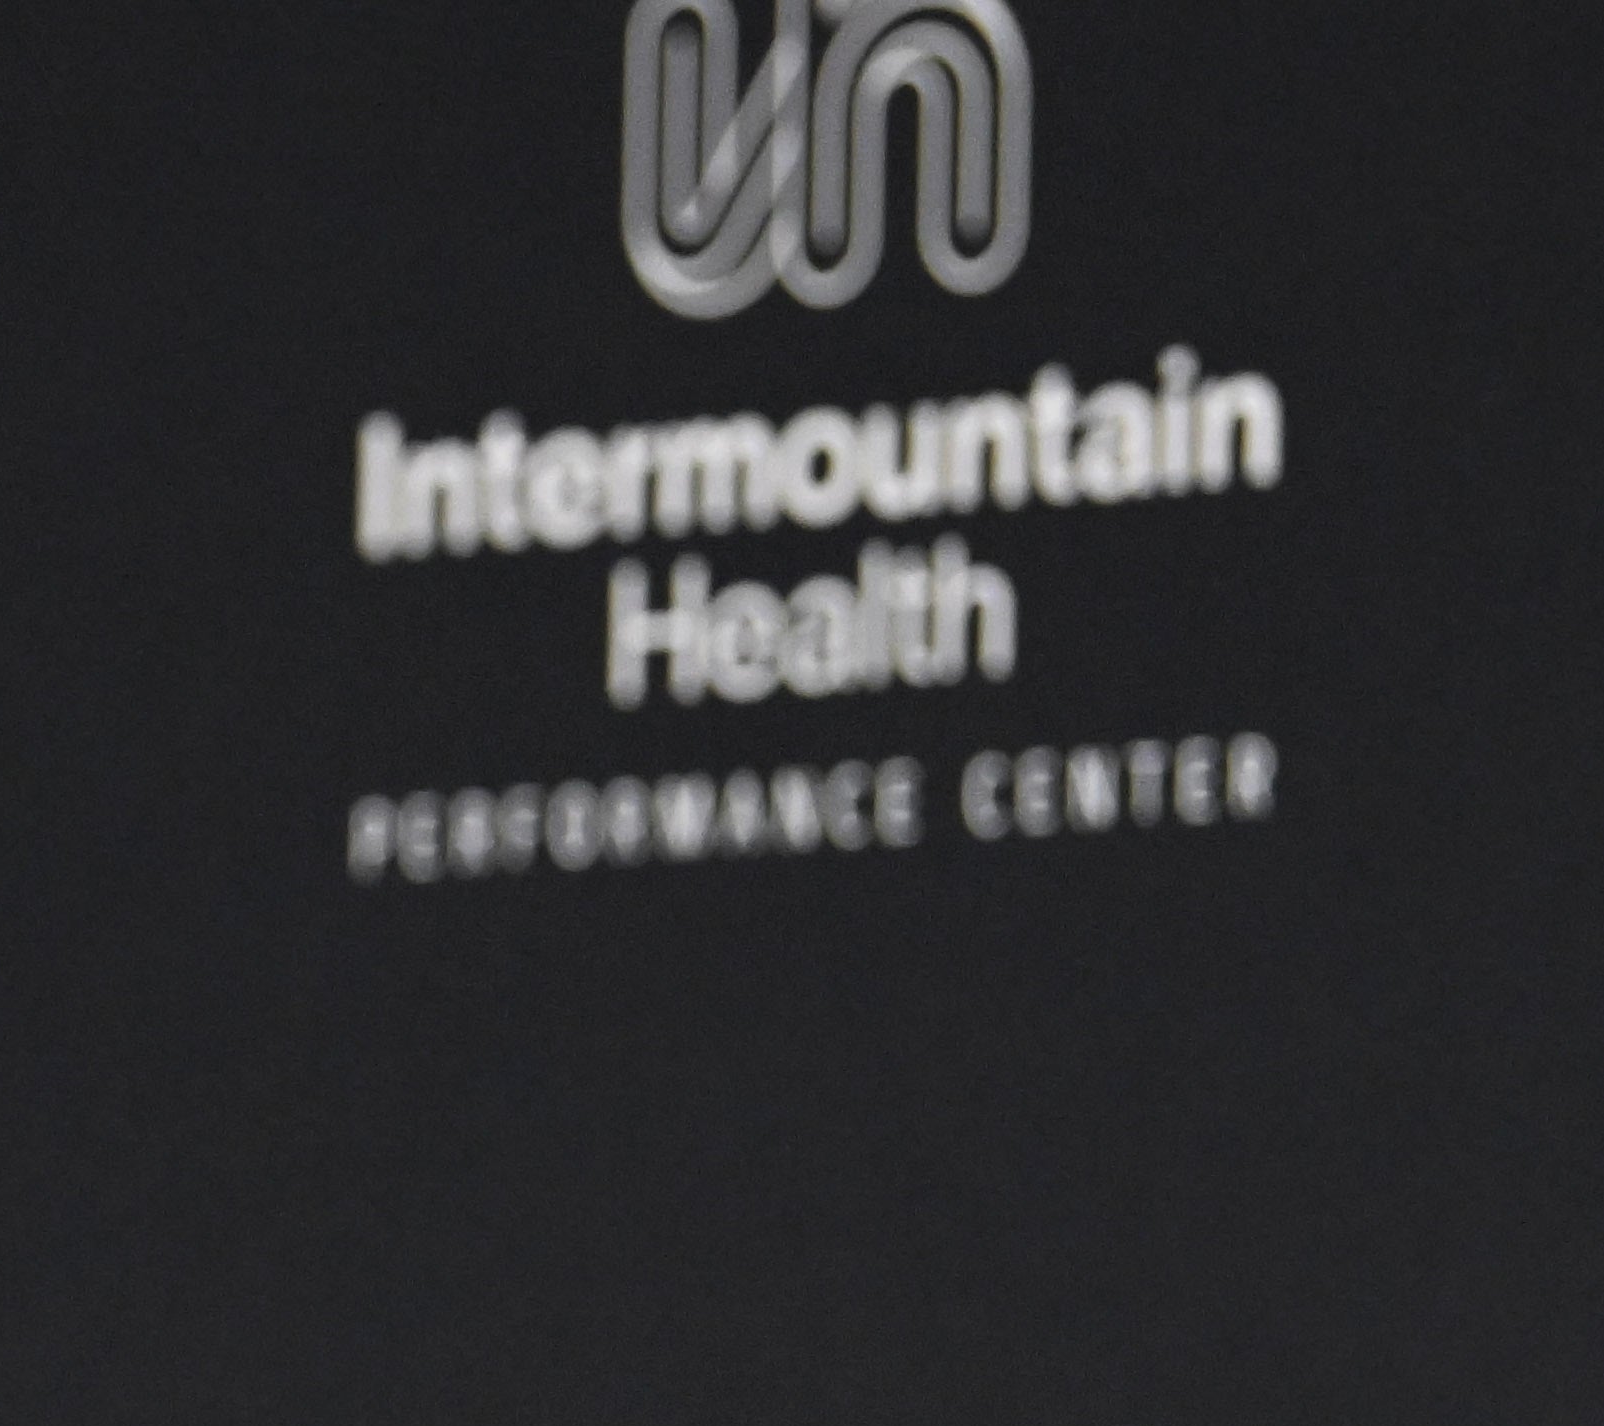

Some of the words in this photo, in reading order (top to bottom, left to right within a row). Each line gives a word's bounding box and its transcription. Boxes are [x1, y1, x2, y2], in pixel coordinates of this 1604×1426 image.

[355, 345, 1283, 560] Intermountain
[605, 535, 1017, 707] Health
[962, 733, 1277, 840] CENTER
